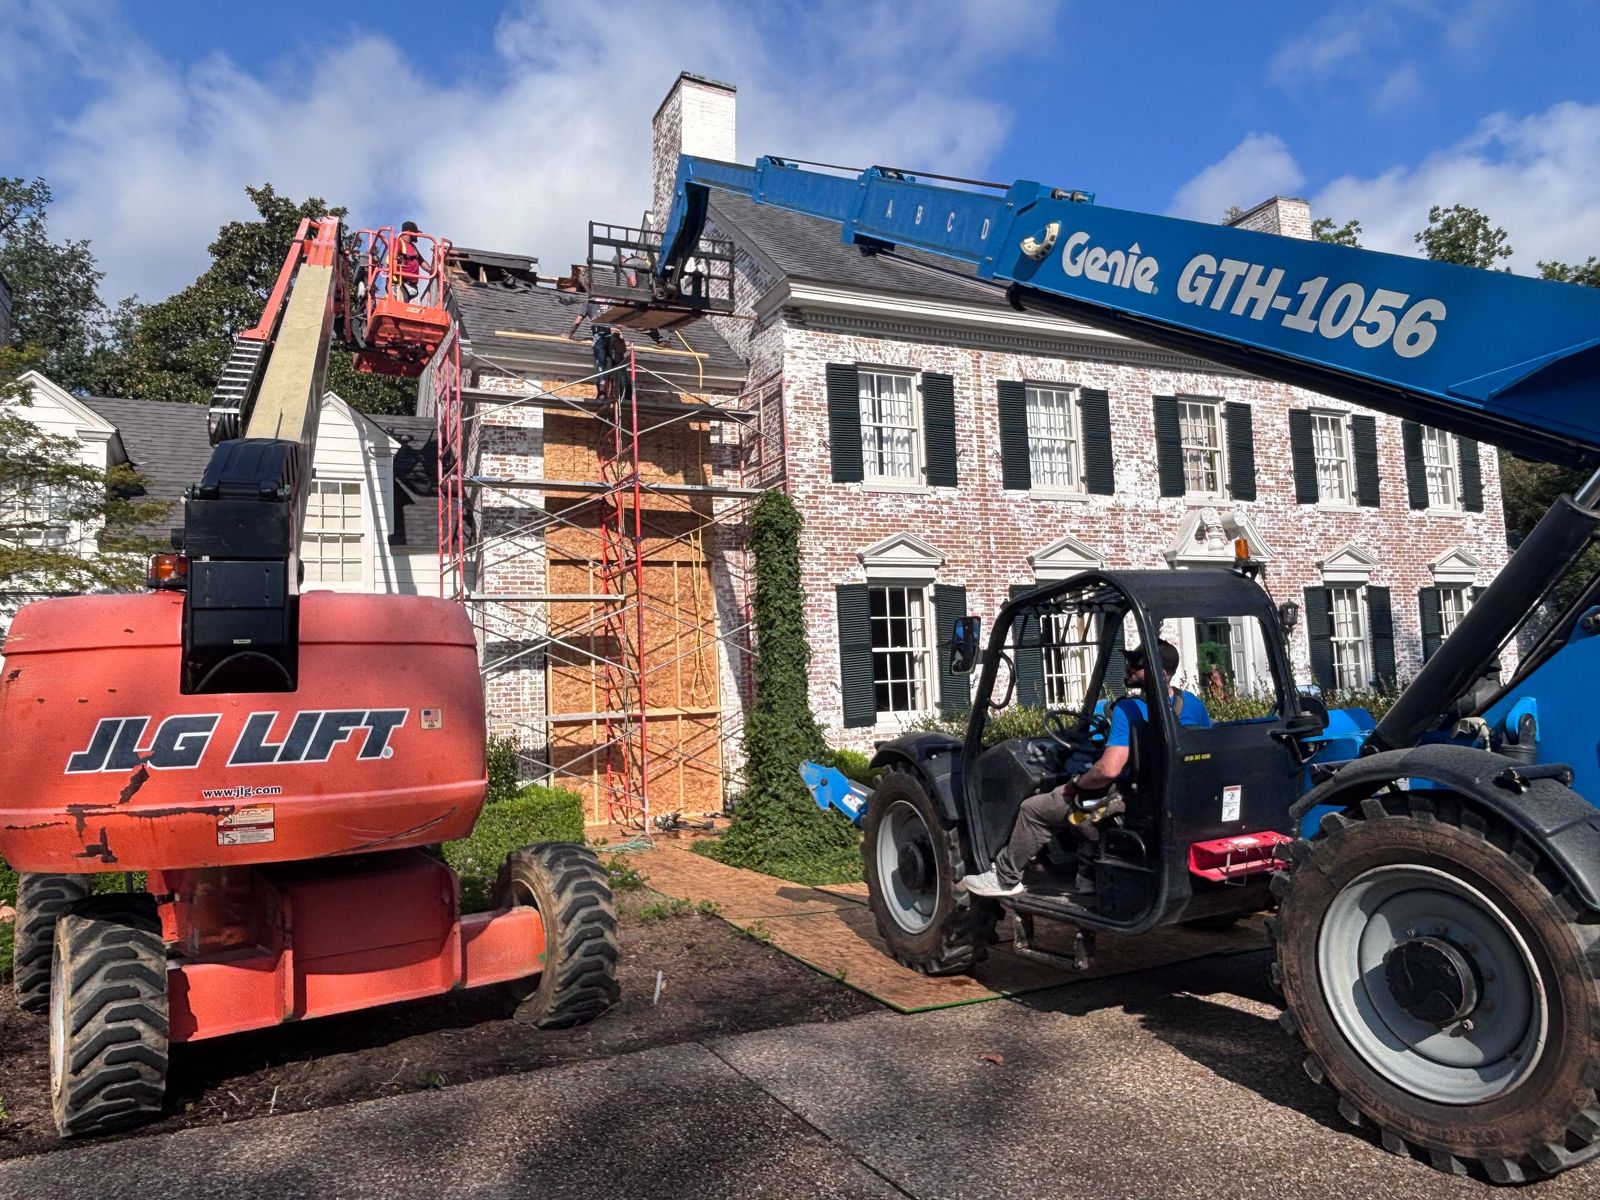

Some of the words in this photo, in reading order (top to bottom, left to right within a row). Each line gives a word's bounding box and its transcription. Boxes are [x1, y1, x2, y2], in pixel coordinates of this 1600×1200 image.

[886, 199, 893, 218] A
[915, 205, 924, 225] B
[947, 211, 955, 232] C
[981, 218, 990, 239] D
[1062, 231, 1158, 294] Genie
[1177, 254, 1446, 358] GTH-1056
[65, 713, 223, 774] JLG
[226, 708, 408, 767] LIFT
[203, 785, 282, 798] www.jlg.com
